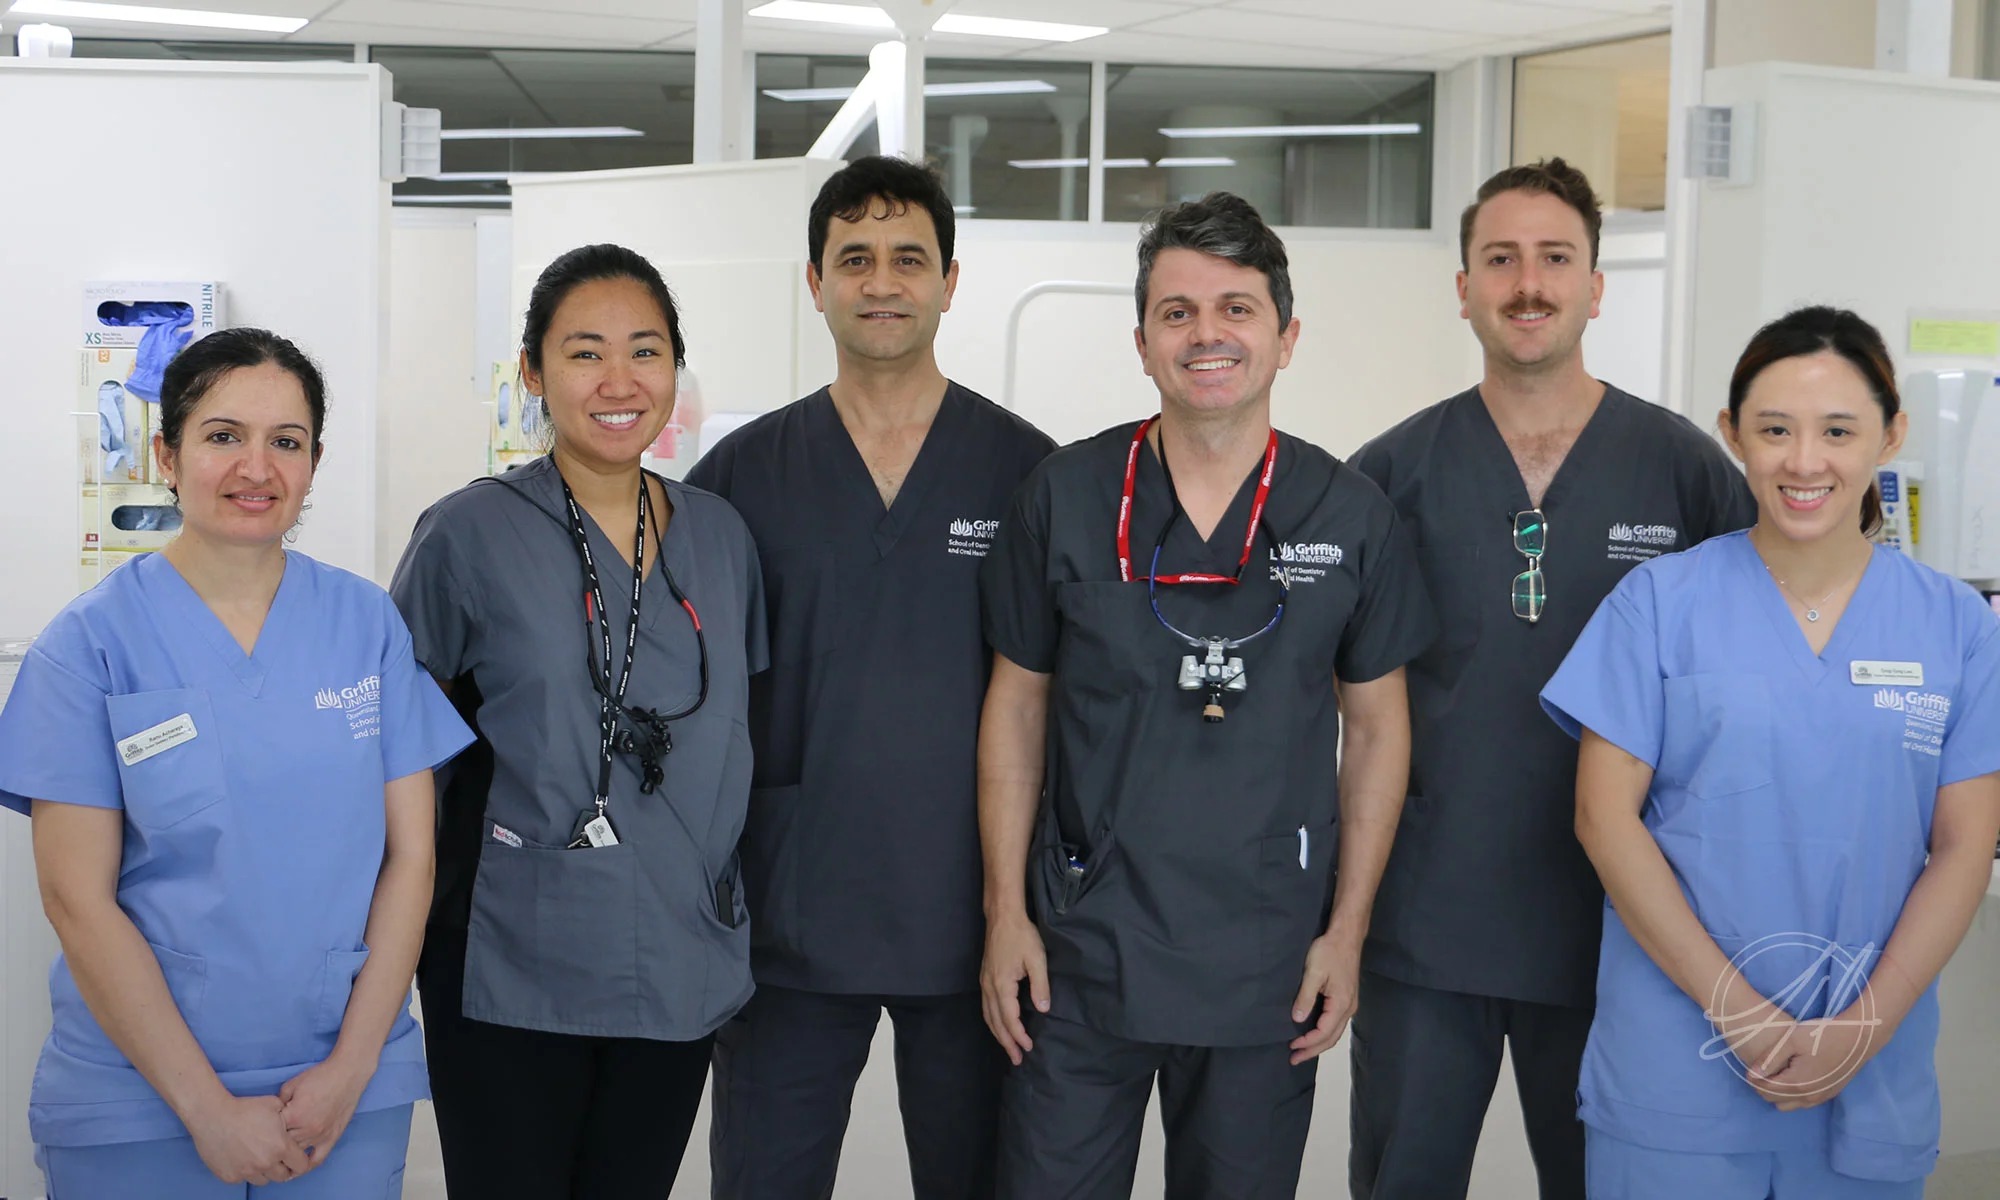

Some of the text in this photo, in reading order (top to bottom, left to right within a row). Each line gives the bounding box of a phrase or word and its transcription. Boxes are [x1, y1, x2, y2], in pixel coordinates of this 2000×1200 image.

[202, 284, 213, 328] NITRILE
[85, 332, 101, 345] XS
[973, 520, 1000, 531] Griff
[1633, 524, 1677, 539] Griffith
[1295, 543, 1343, 558] Griffith
[1607, 544, 1628, 553] School
[1295, 554, 1342, 565] UNIVERSITY
[1298, 567, 1326, 577] Dentistry
[341, 675, 380, 700] Griffi
[343, 690, 380, 709] UNIVER
[1905, 691, 1951, 713] Griffit
